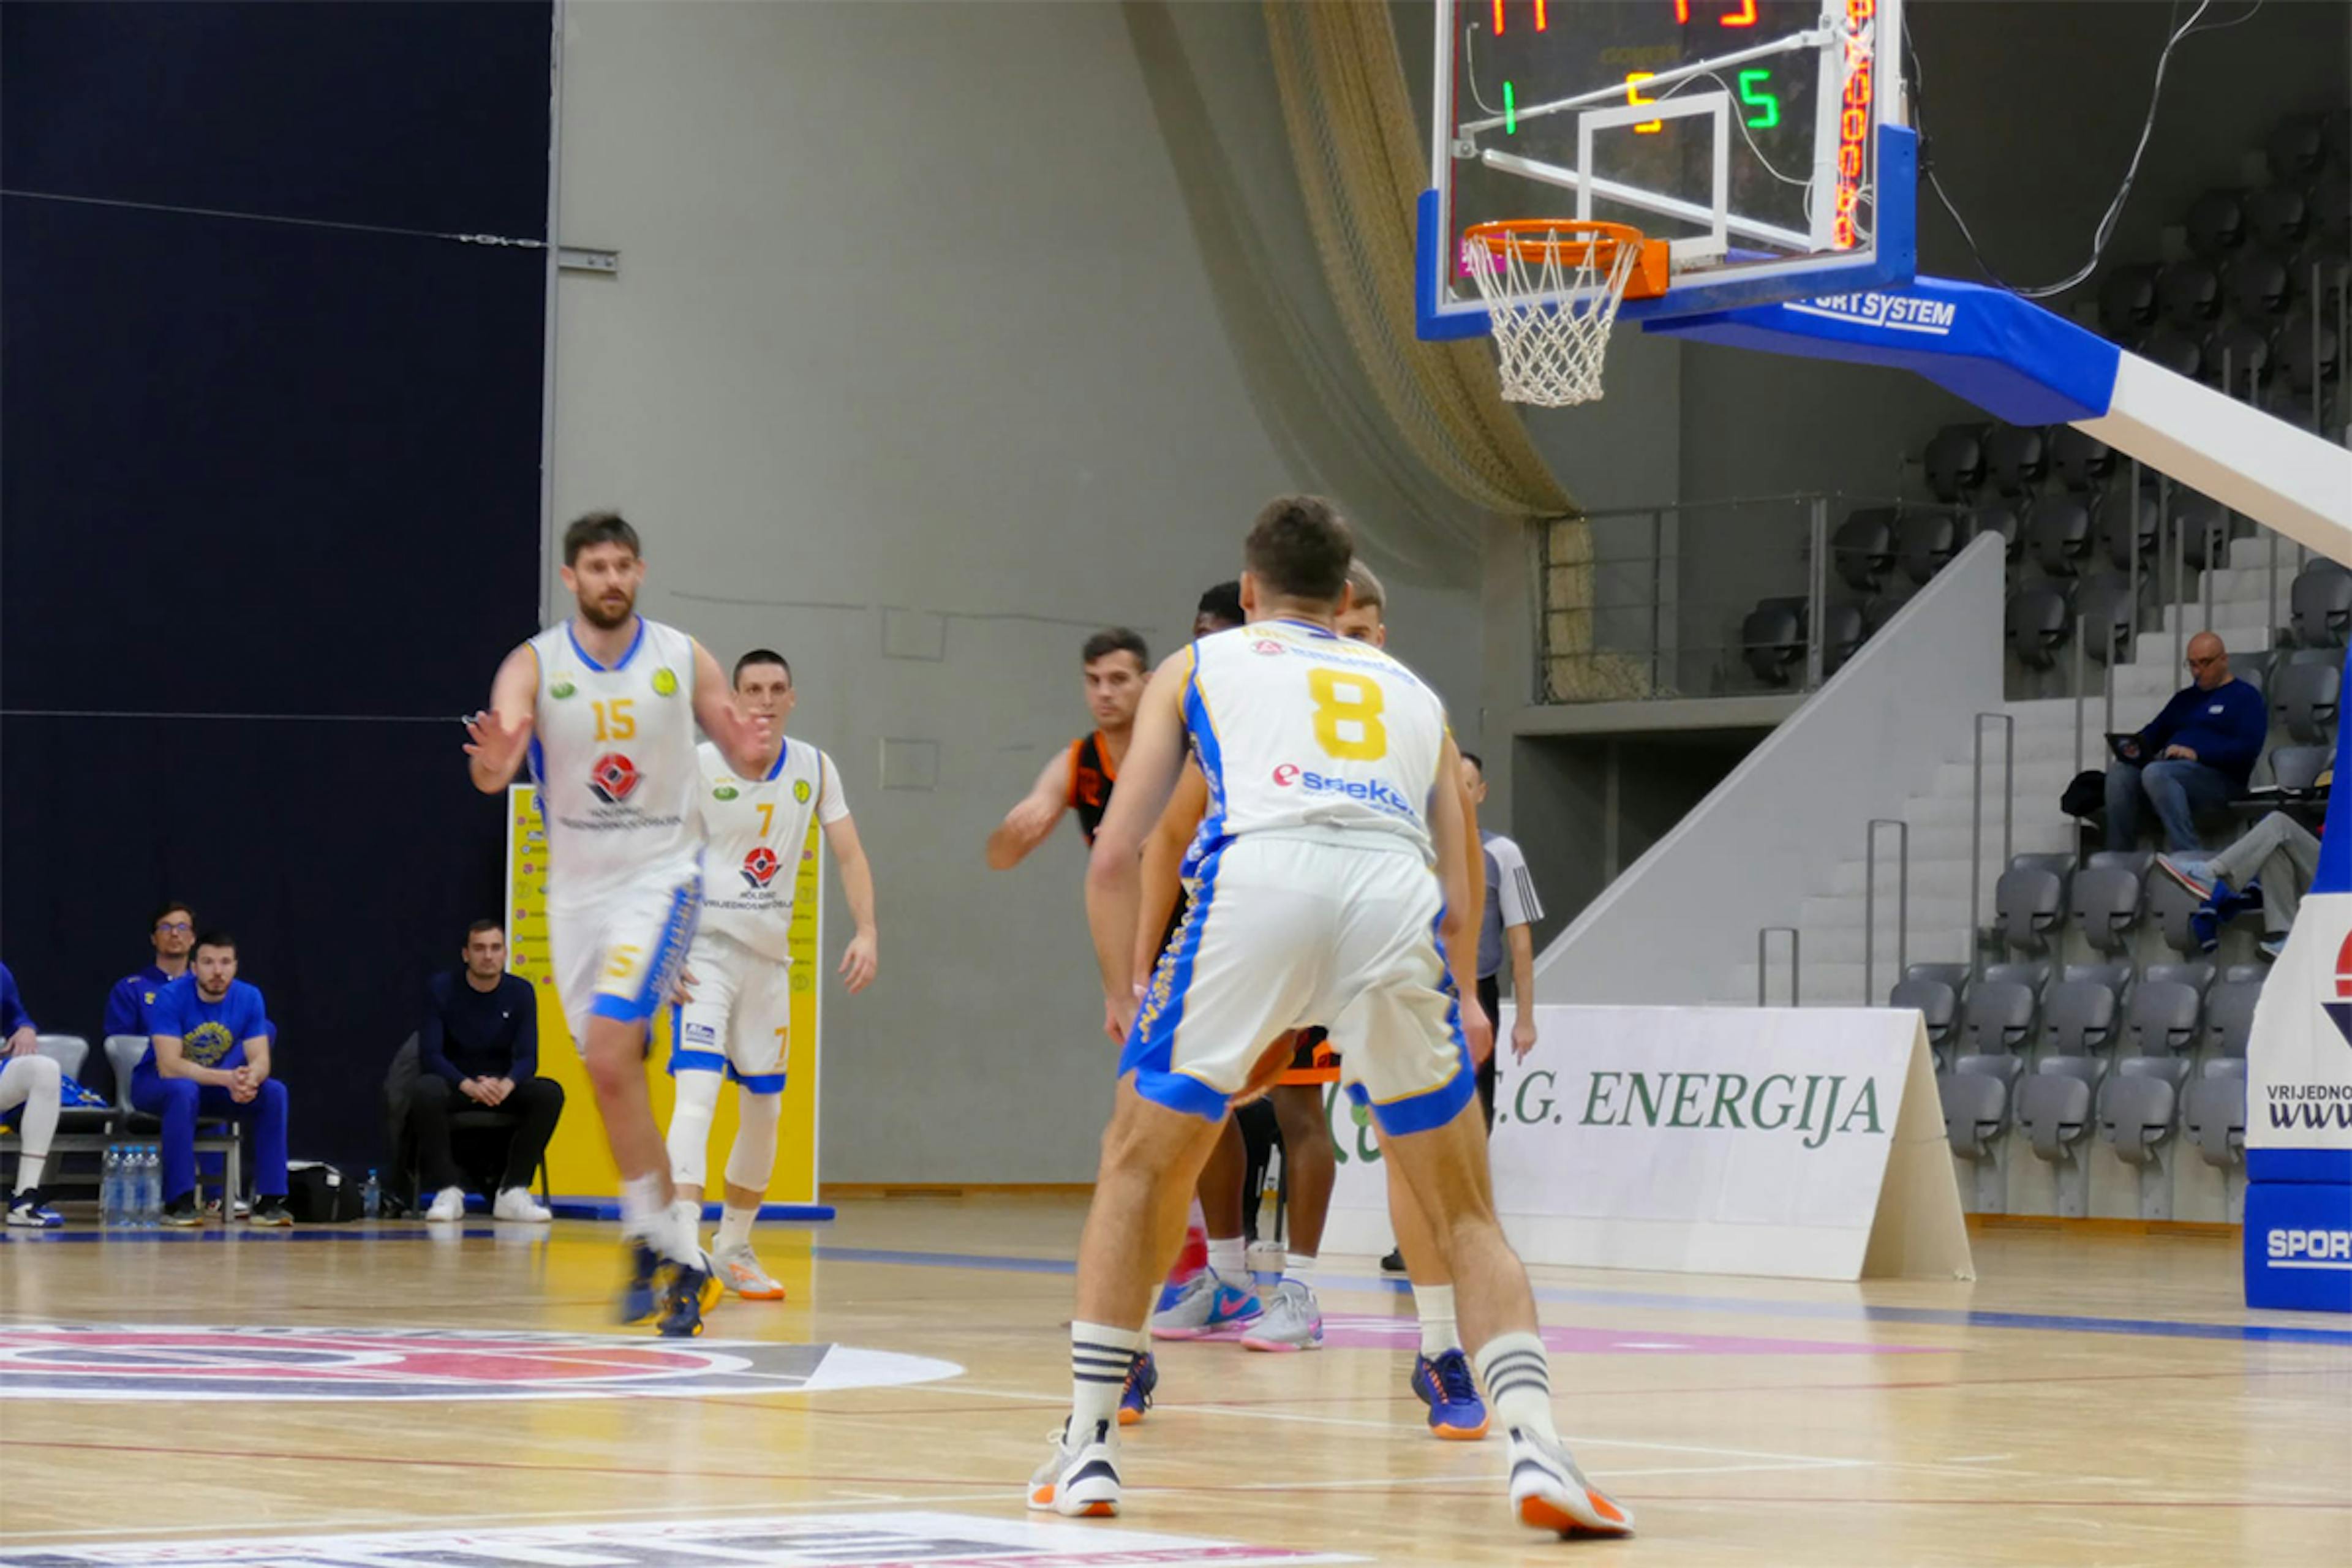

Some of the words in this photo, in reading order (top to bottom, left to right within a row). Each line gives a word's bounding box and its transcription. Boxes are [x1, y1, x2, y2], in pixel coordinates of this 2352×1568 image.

[1738, 69, 1779, 128] 5
[591, 698, 636, 742] 15
[1306, 668, 1387, 761] 8
[756, 803, 775, 838] 7
[1493, 1070, 1562, 1125] .G.
[1578, 1072, 1885, 1148] ENERGIJA
[2267, 1229, 2352, 1258] SPOR
